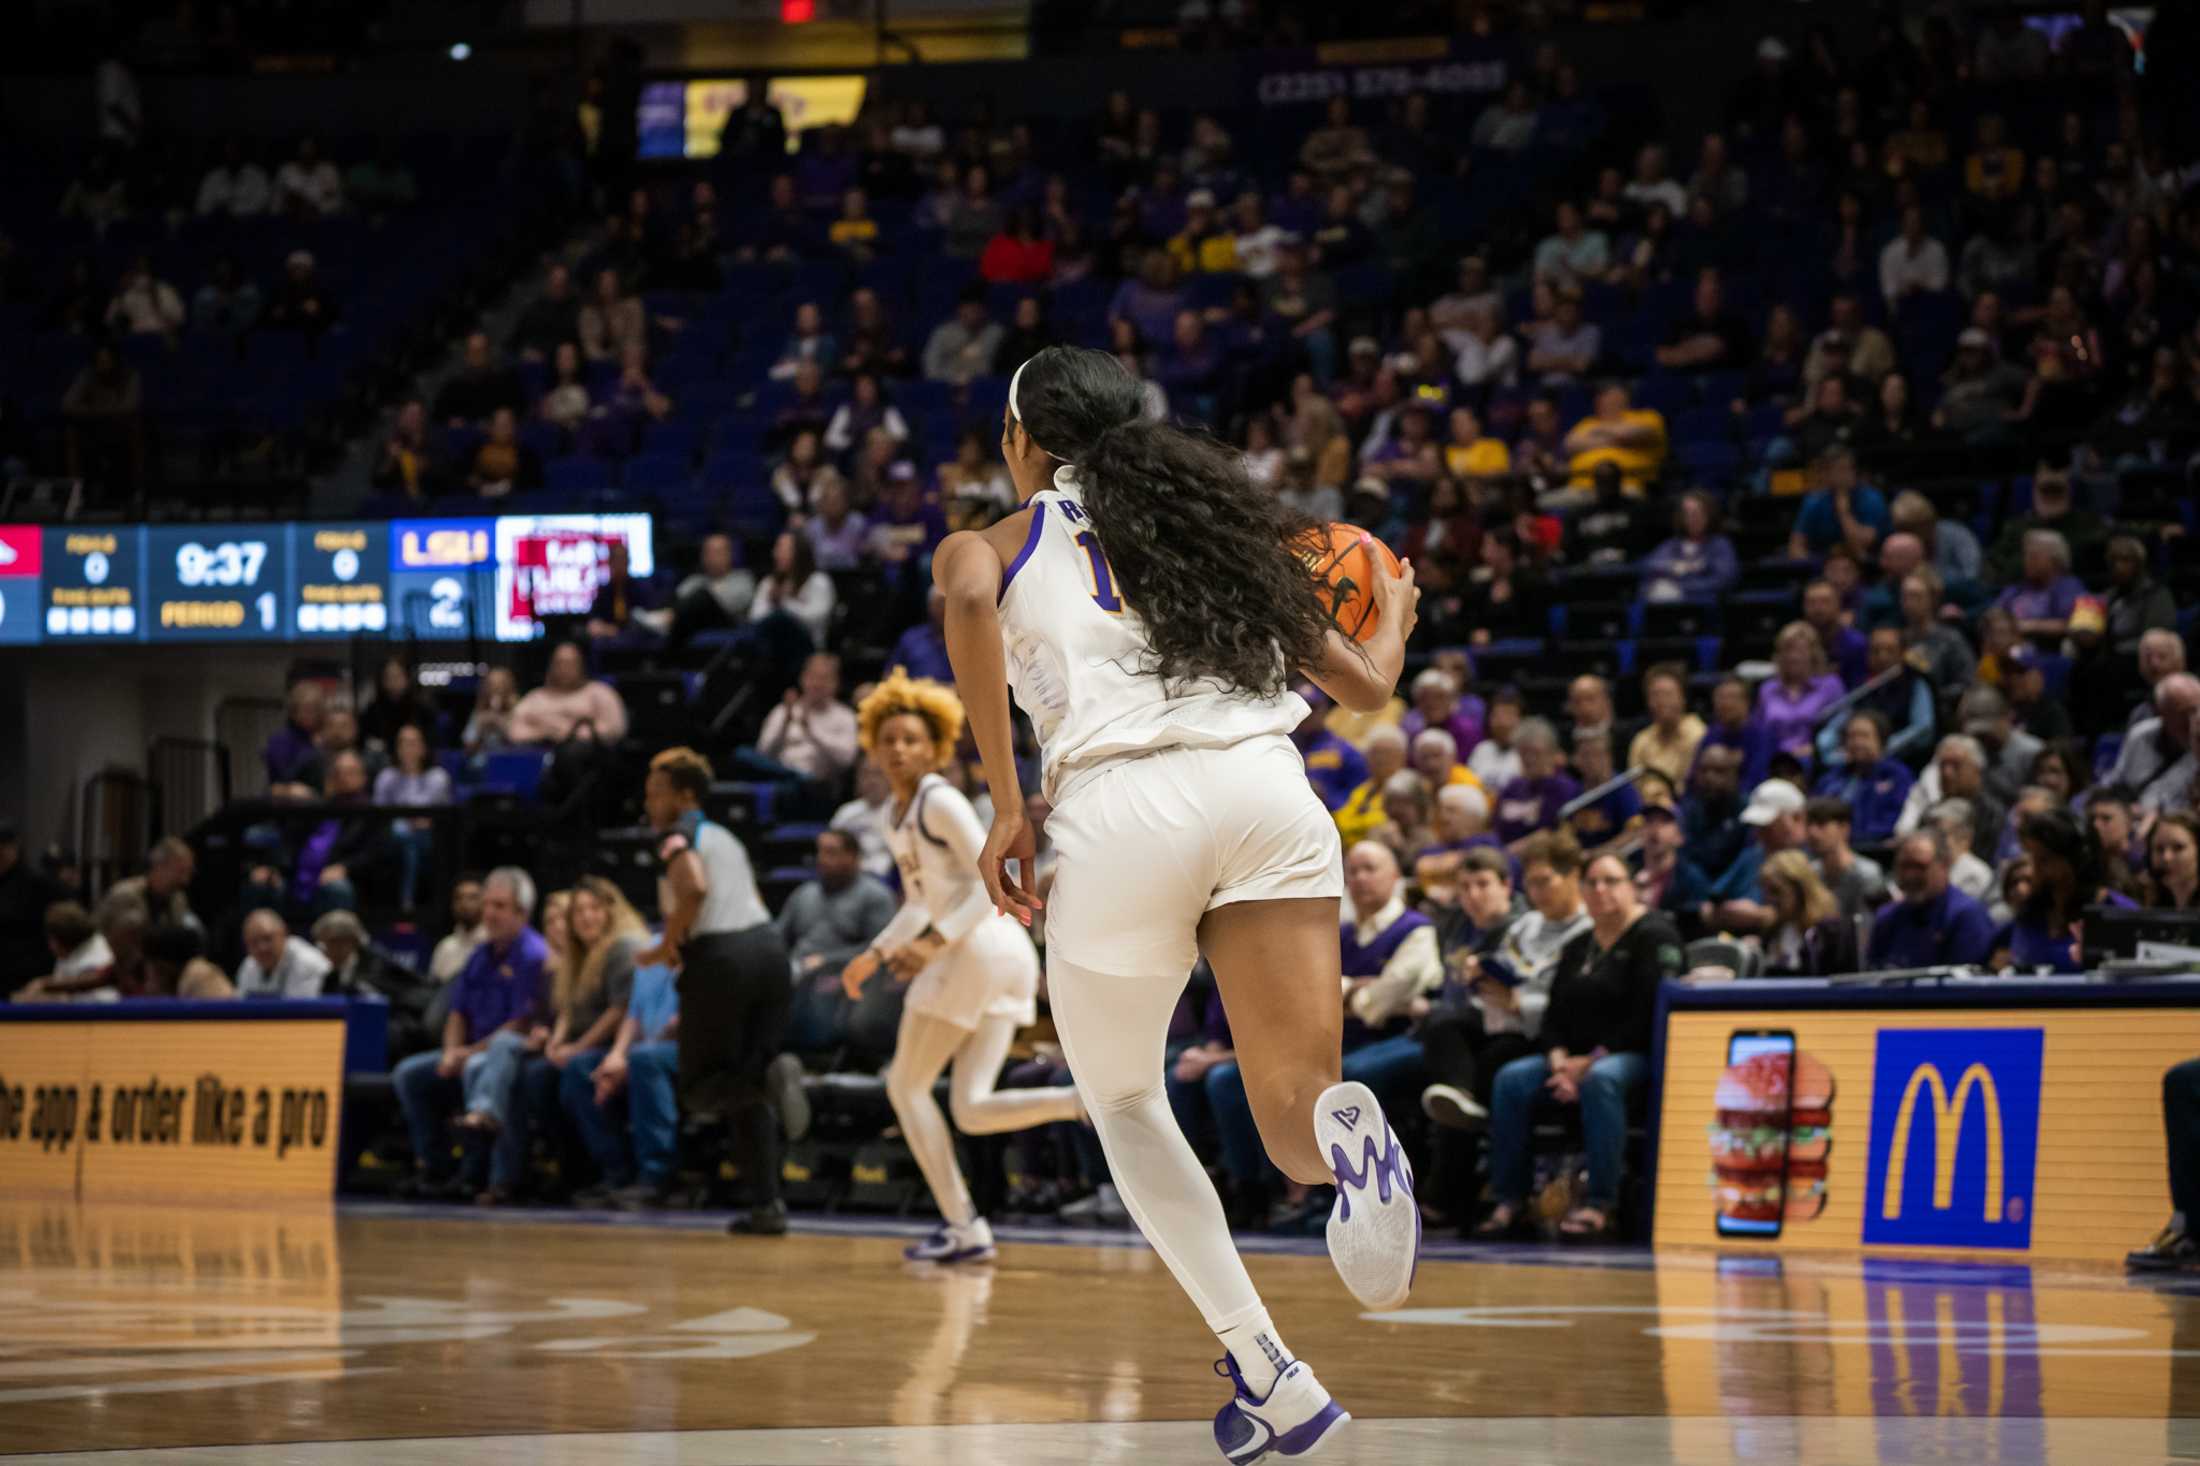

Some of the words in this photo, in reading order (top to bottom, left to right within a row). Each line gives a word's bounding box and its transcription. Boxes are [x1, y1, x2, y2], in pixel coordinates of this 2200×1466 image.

[176, 541, 268, 586] 9:37
[255, 592, 277, 631] 1
[429, 577, 464, 628] 2
[30, 1084, 78, 1152] app
[112, 1074, 187, 1144] order
[192, 1071, 246, 1146] like
[252, 1086, 271, 1146] a
[276, 1088, 328, 1160] pro
